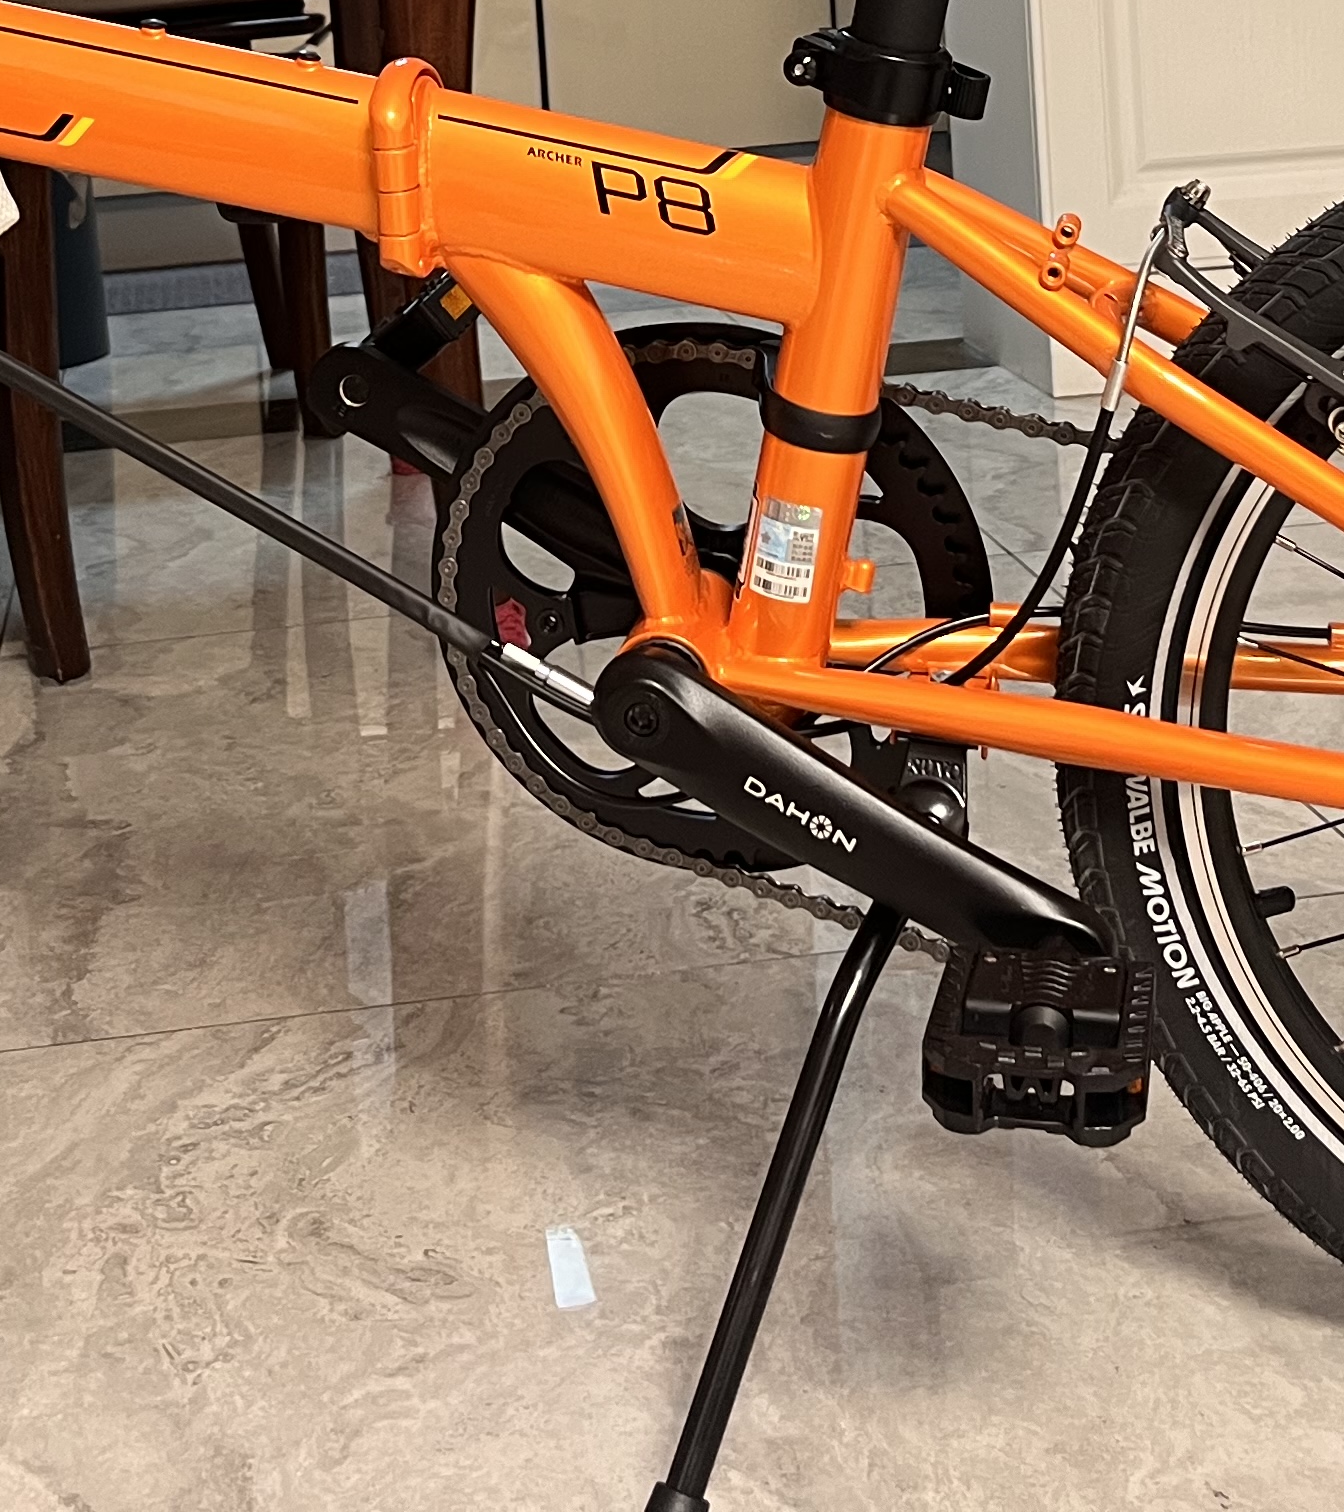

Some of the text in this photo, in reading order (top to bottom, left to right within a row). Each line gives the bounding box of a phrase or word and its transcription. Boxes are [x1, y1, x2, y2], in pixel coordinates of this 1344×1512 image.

[527, 146, 583, 167] ARCHER
[591, 160, 716, 236] P8
[743, 775, 857, 852] DAHON
[1135, 861, 1200, 990] MOTION
[1195, 990, 1213, 1011] BIG
[1207, 1012, 1233, 1044] APPLE
[1237, 1056, 1268, 1093] 50-406
[1206, 1033, 1226, 1056] BAR
[1226, 1062, 1253, 1093] 32-65
[1247, 1092, 1265, 1110] PSI
